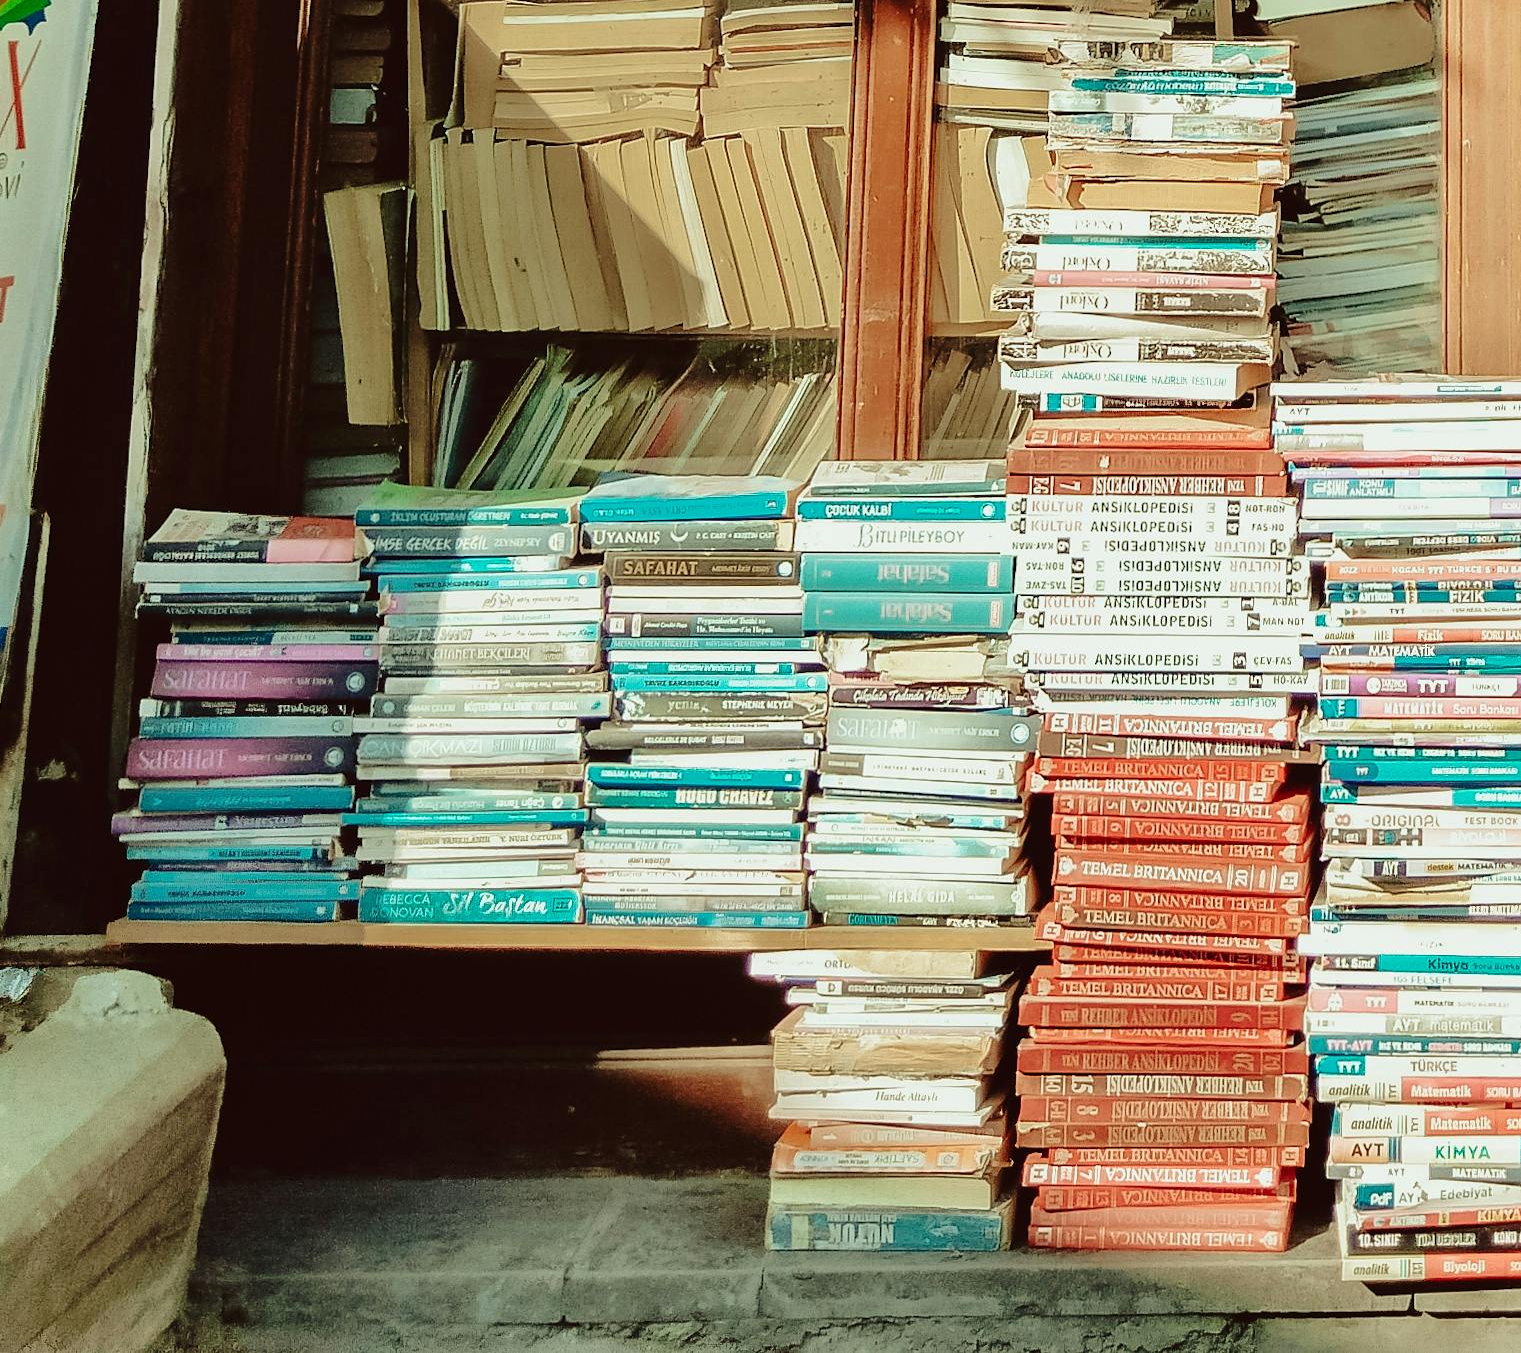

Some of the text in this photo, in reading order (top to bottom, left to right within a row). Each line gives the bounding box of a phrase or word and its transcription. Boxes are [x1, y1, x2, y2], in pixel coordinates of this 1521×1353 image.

[1063, 256, 1111, 271] Oxford
[1060, 295, 1109, 311] Oxford
[1063, 343, 1112, 358] Oxford
[1179, 478, 1225, 495] REHBER
[825, 503, 892, 518] ÇOCUK KALBİ
[593, 530, 661, 545] UYANMIŞ
[623, 561, 699, 576] SAFAHAT
[1417, 630, 1443, 641] Fizik
[1481, 630, 1507, 641] SORU
[1328, 645, 1436, 657] AYT MATEMATİK
[1417, 680, 1449, 693] TYT
[1384, 701, 1519, 715] MATEMATİK Soru Bankası
[1123, 719, 1264, 735] TEMEL BRITANNICA
[1337, 747, 1359, 758] TYT
[1062, 760, 1204, 776] TEMEL BRITANNICA
[675, 789, 774, 805] HUGO CHAVEZ
[1131, 801, 1272, 817] TEMEL BRITANNICA
[1490, 817, 1519, 825] BOOK
[1135, 823, 1277, 838] TEMEL BRITANNICA
[1082, 861, 1130, 877] TEMEL
[1134, 863, 1223, 883] BRITANNICA
[1427, 862, 1454, 872] destek
[1134, 893, 1276, 911] TEMEL BRITANNICA
[1085, 910, 1227, 930] TEMEL BRITANNICA
[1428, 959, 1469, 971] Kimya
[1060, 982, 1203, 999] TEMEL BRITANNICA
[1082, 1008, 1130, 1024] REHBER
[1392, 1018, 1494, 1032] AYT matematik
[1082, 1052, 1131, 1069] REHBER
[1337, 1059, 1458, 1074] TYT TÜRKÇE
[1196, 1077, 1243, 1094] REHBER
[1328, 1084, 1371, 1096] analitik
[1411, 1085, 1472, 1098] Matematik
[1486, 1087, 1510, 1098] SORU
[875, 1091, 906, 1102] Hande
[1350, 1117, 1393, 1130] analitik
[1430, 1117, 1493, 1131] Matematik
[1078, 1148, 1224, 1163] TEMEL BRITANNICA
[1351, 1142, 1491, 1160] AYT KİMYA
[1106, 1168, 1250, 1184] TEMEL BRITANNICA
[1440, 1186, 1493, 1201] Edebiyat
[1353, 1263, 1390, 1276] analitik
[1443, 1260, 1486, 1273] Biyoloji
